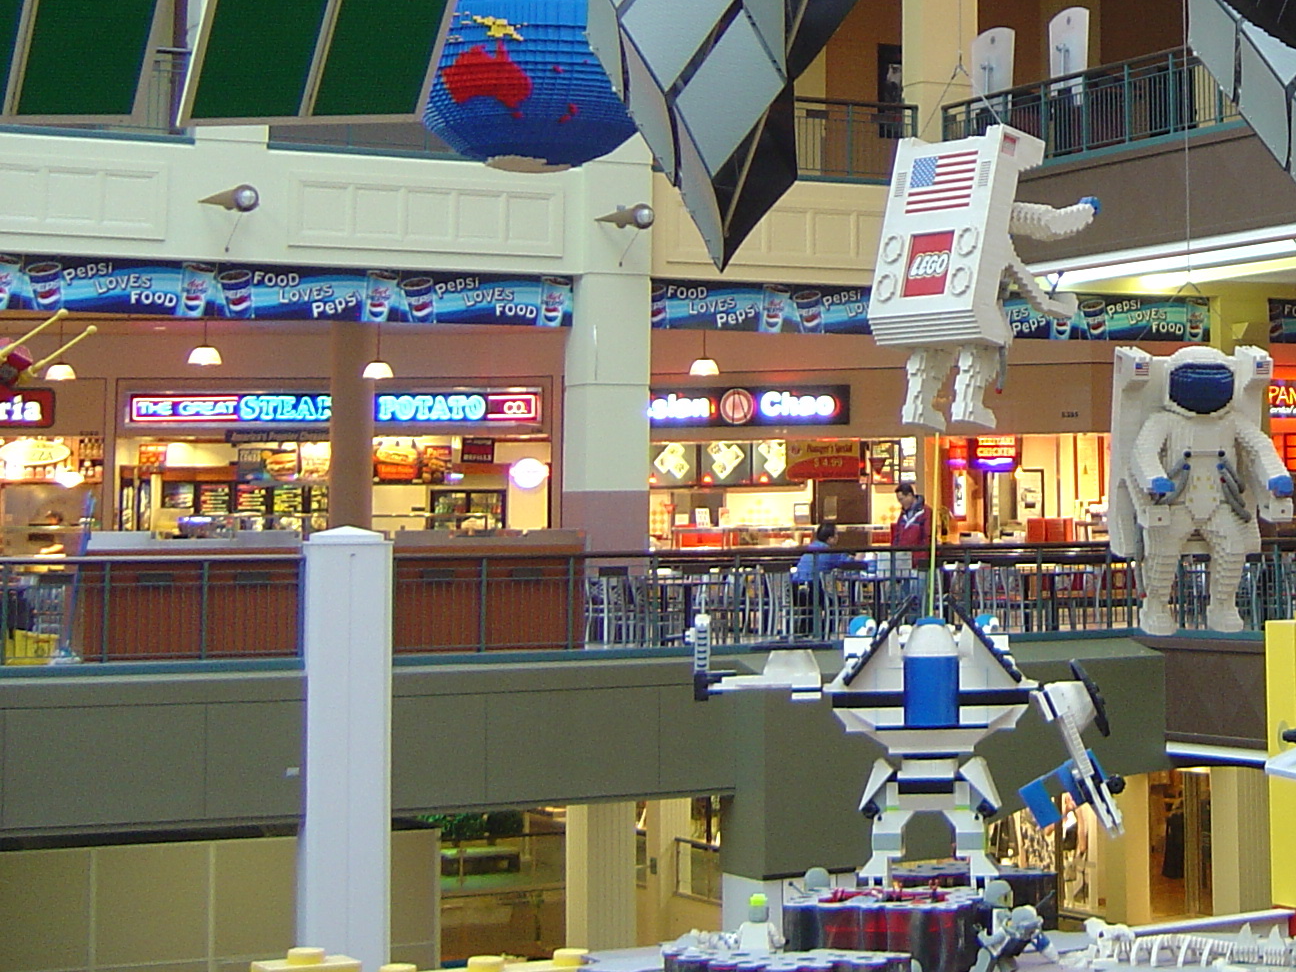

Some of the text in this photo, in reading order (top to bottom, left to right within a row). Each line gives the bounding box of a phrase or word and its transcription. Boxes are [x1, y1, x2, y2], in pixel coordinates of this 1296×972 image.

[62, 262, 113, 285] Pepsi
[908, 250, 950, 279] LEGO
[94, 273, 153, 295] LOVES
[253, 270, 300, 287] FOOD
[435, 277, 479, 298] Pepsi
[130, 290, 178, 307] FOOD
[278, 284, 335, 304] LOVES
[463, 287, 514, 307] LOVES
[666, 284, 708, 299] FOOD
[822, 291, 861, 310] Pepsi
[312, 290, 361, 318] Pepsi
[495, 303, 537, 319] FOOD
[688, 297, 736, 315] LOVES
[1106, 299, 1141, 319] Pepsi
[716, 304, 760, 328] Pepsi
[1152, 321, 1184, 336] FOOD
[0, 394, 42, 422] ria
[137, 401, 173, 416] THE
[179, 401, 238, 416] GREAT
[377, 393, 487, 421] POTATO
[651, 391, 836, 419] sian Chao
